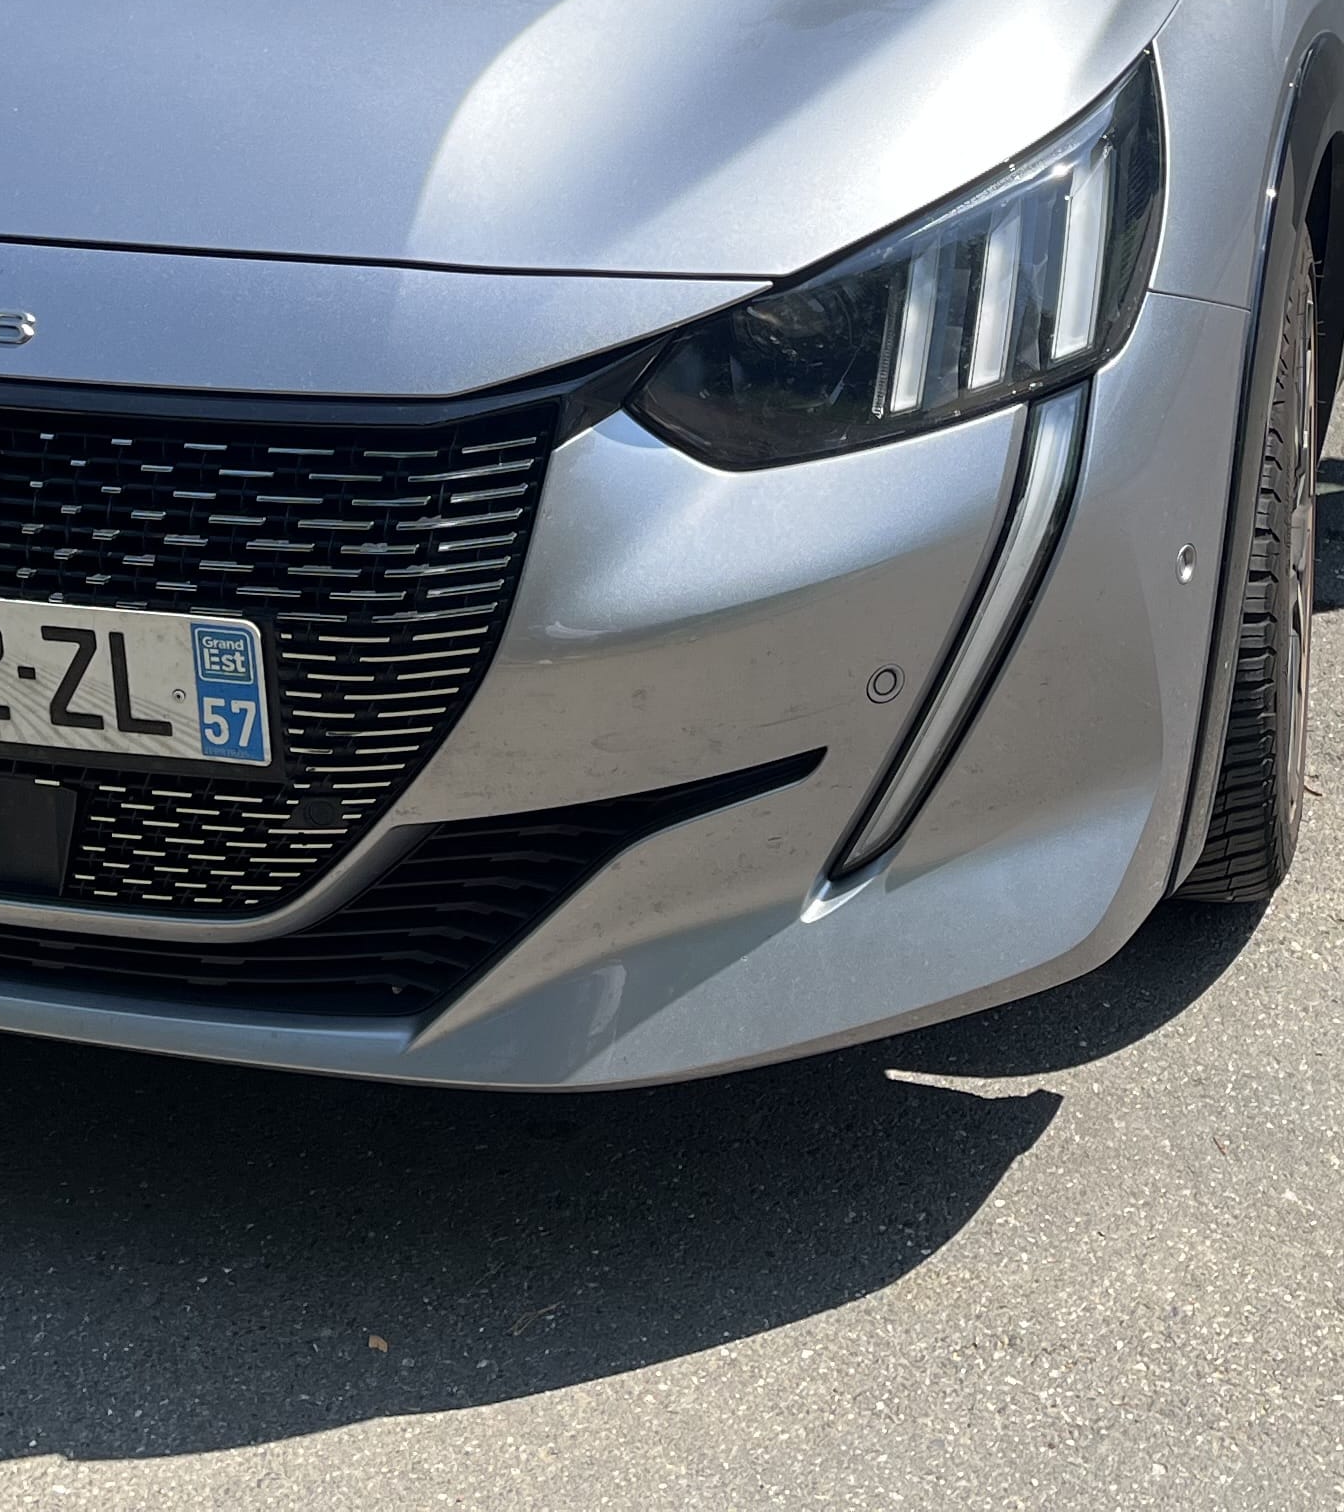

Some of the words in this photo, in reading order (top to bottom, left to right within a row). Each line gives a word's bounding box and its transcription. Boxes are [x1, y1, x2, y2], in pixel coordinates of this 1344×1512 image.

[202, 636, 244, 651] Grand
[204, 648, 246, 673] Est
[202, 696, 256, 747] 57
